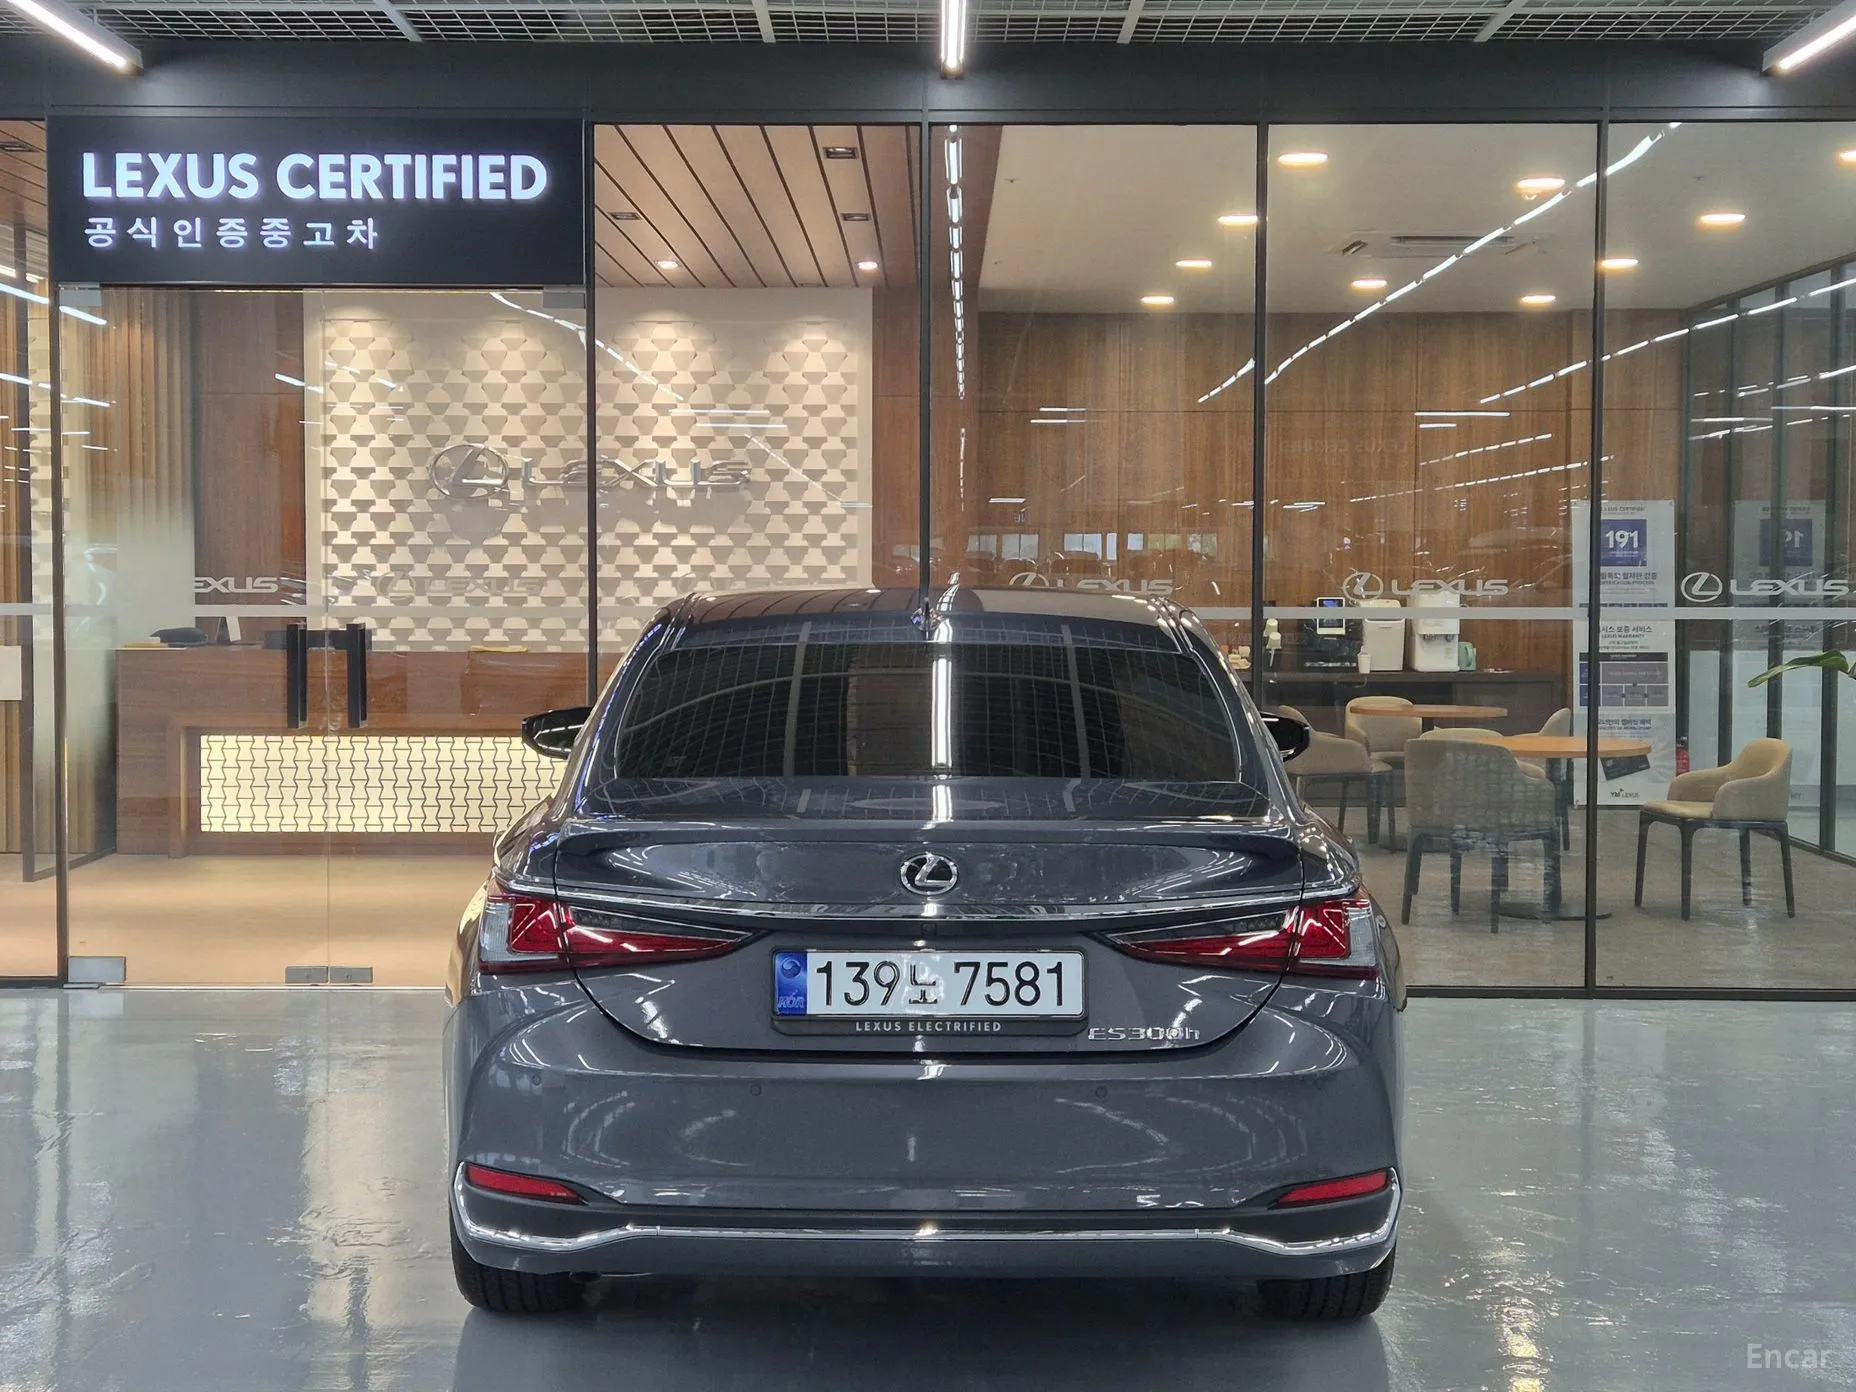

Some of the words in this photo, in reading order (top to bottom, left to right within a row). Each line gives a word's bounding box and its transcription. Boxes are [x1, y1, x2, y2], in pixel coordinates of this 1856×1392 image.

[82, 152, 260, 200] LEXUS
[276, 152, 549, 201] CERTIFIED
[84, 216, 379, 250] 공식인증중고차
[521, 456, 751, 488] LEXUS
[1606, 530, 1639, 548] 191
[194, 577, 279, 594] EXUS
[1391, 579, 1509, 596] LEXUS
[1730, 579, 1849, 596] LEXUS
[816, 960, 938, 1007] 139노
[953, 960, 1063, 1007] 7581
[855, 1021, 901, 1033] LEXUS
[908, 1021, 1001, 1033] ELECTRIFIED
